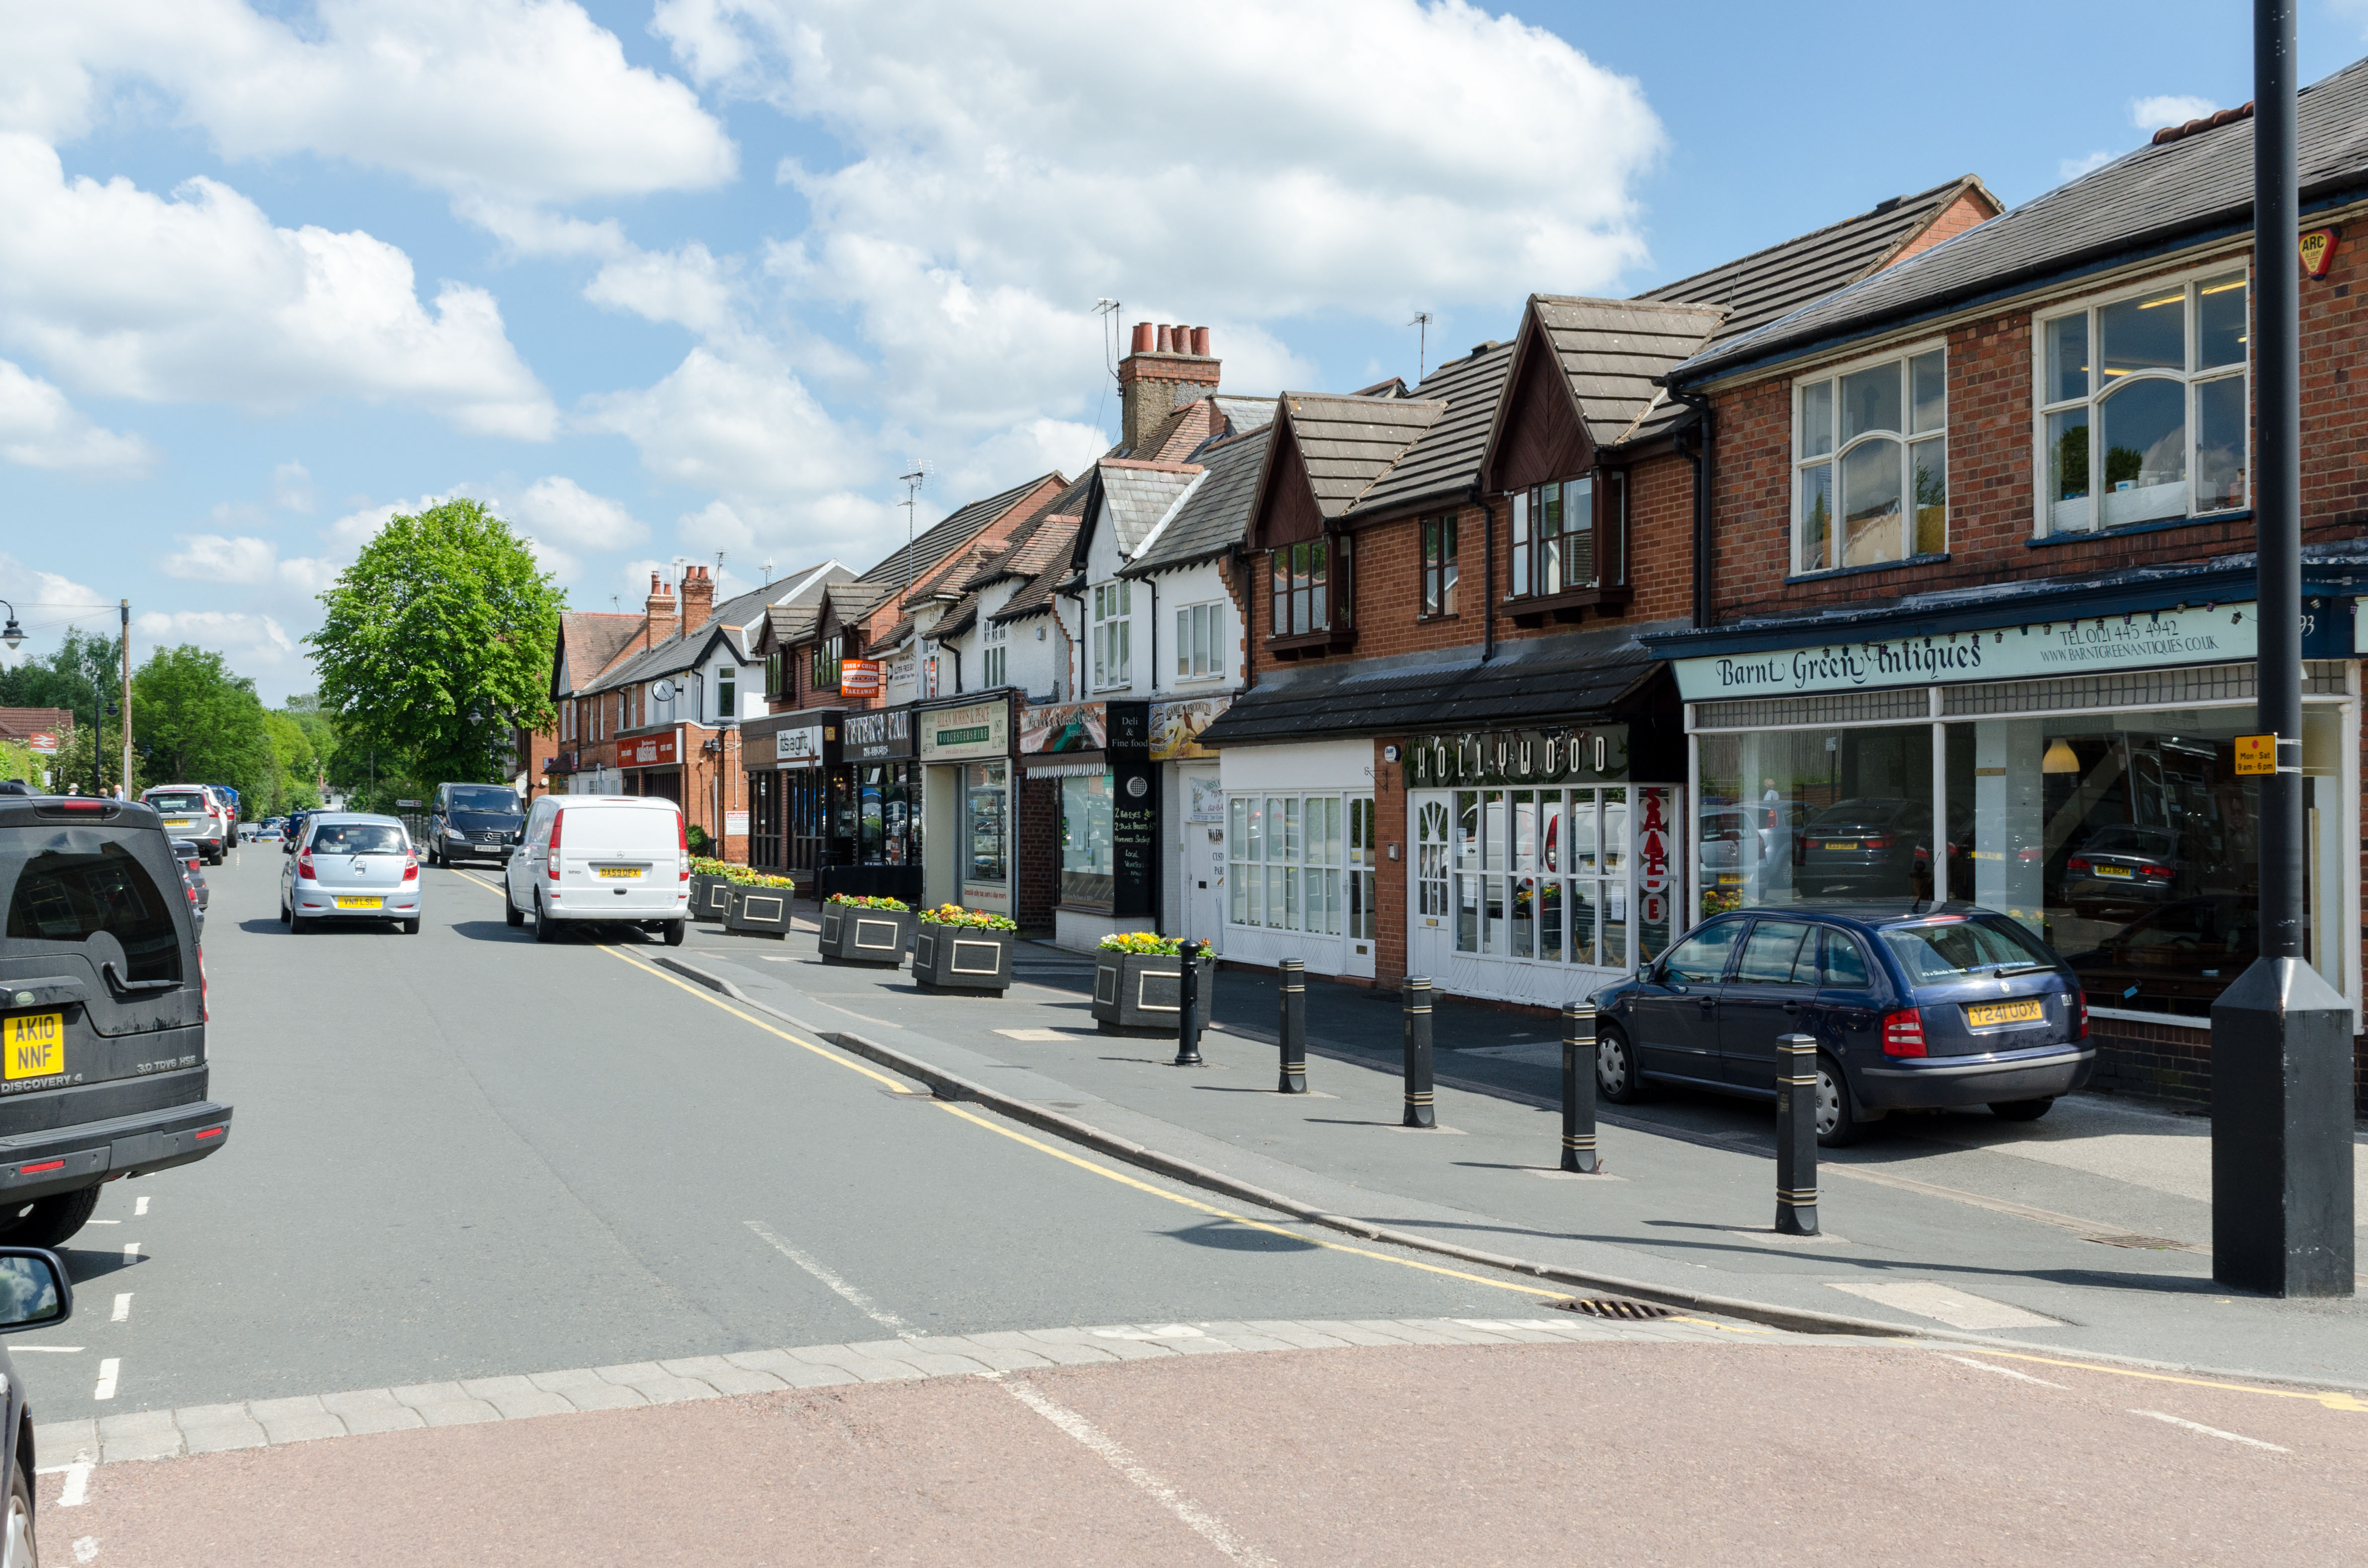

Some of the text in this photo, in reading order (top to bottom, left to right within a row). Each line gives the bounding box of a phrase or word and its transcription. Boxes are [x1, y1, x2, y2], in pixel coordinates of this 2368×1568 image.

[2302, 235, 2324, 252] ARC
[2114, 624, 2140, 641] 445
[2146, 620, 2179, 638] 4942
[1716, 643, 1981, 689] Barnt Green Antiques
[937, 711, 951, 727] ALLAN
[953, 710, 969, 725] MORRIS
[975, 707, 990, 722] PEACE
[1167, 702, 1211, 717] GAME PRODUCTS
[844, 711, 909, 745] PETER'S PAN
[938, 728, 987, 743] WORCESTERSHIRE
[1418, 736, 1605, 779] HOLLYWOOD
[1115, 808, 1119, 818] 2
[1114, 822, 1118, 831] 2
[1212, 853, 1224, 861] CUST
[1974, 1001, 2037, 1021] Y241 UOX
[15, 1016, 55, 1043] AK10
[18, 1044, 53, 1070] NNF
[137, 1055, 196, 1074] 3.0 TDV6 HSE
[1, 1073, 83, 1093] DISCOVERY 4
